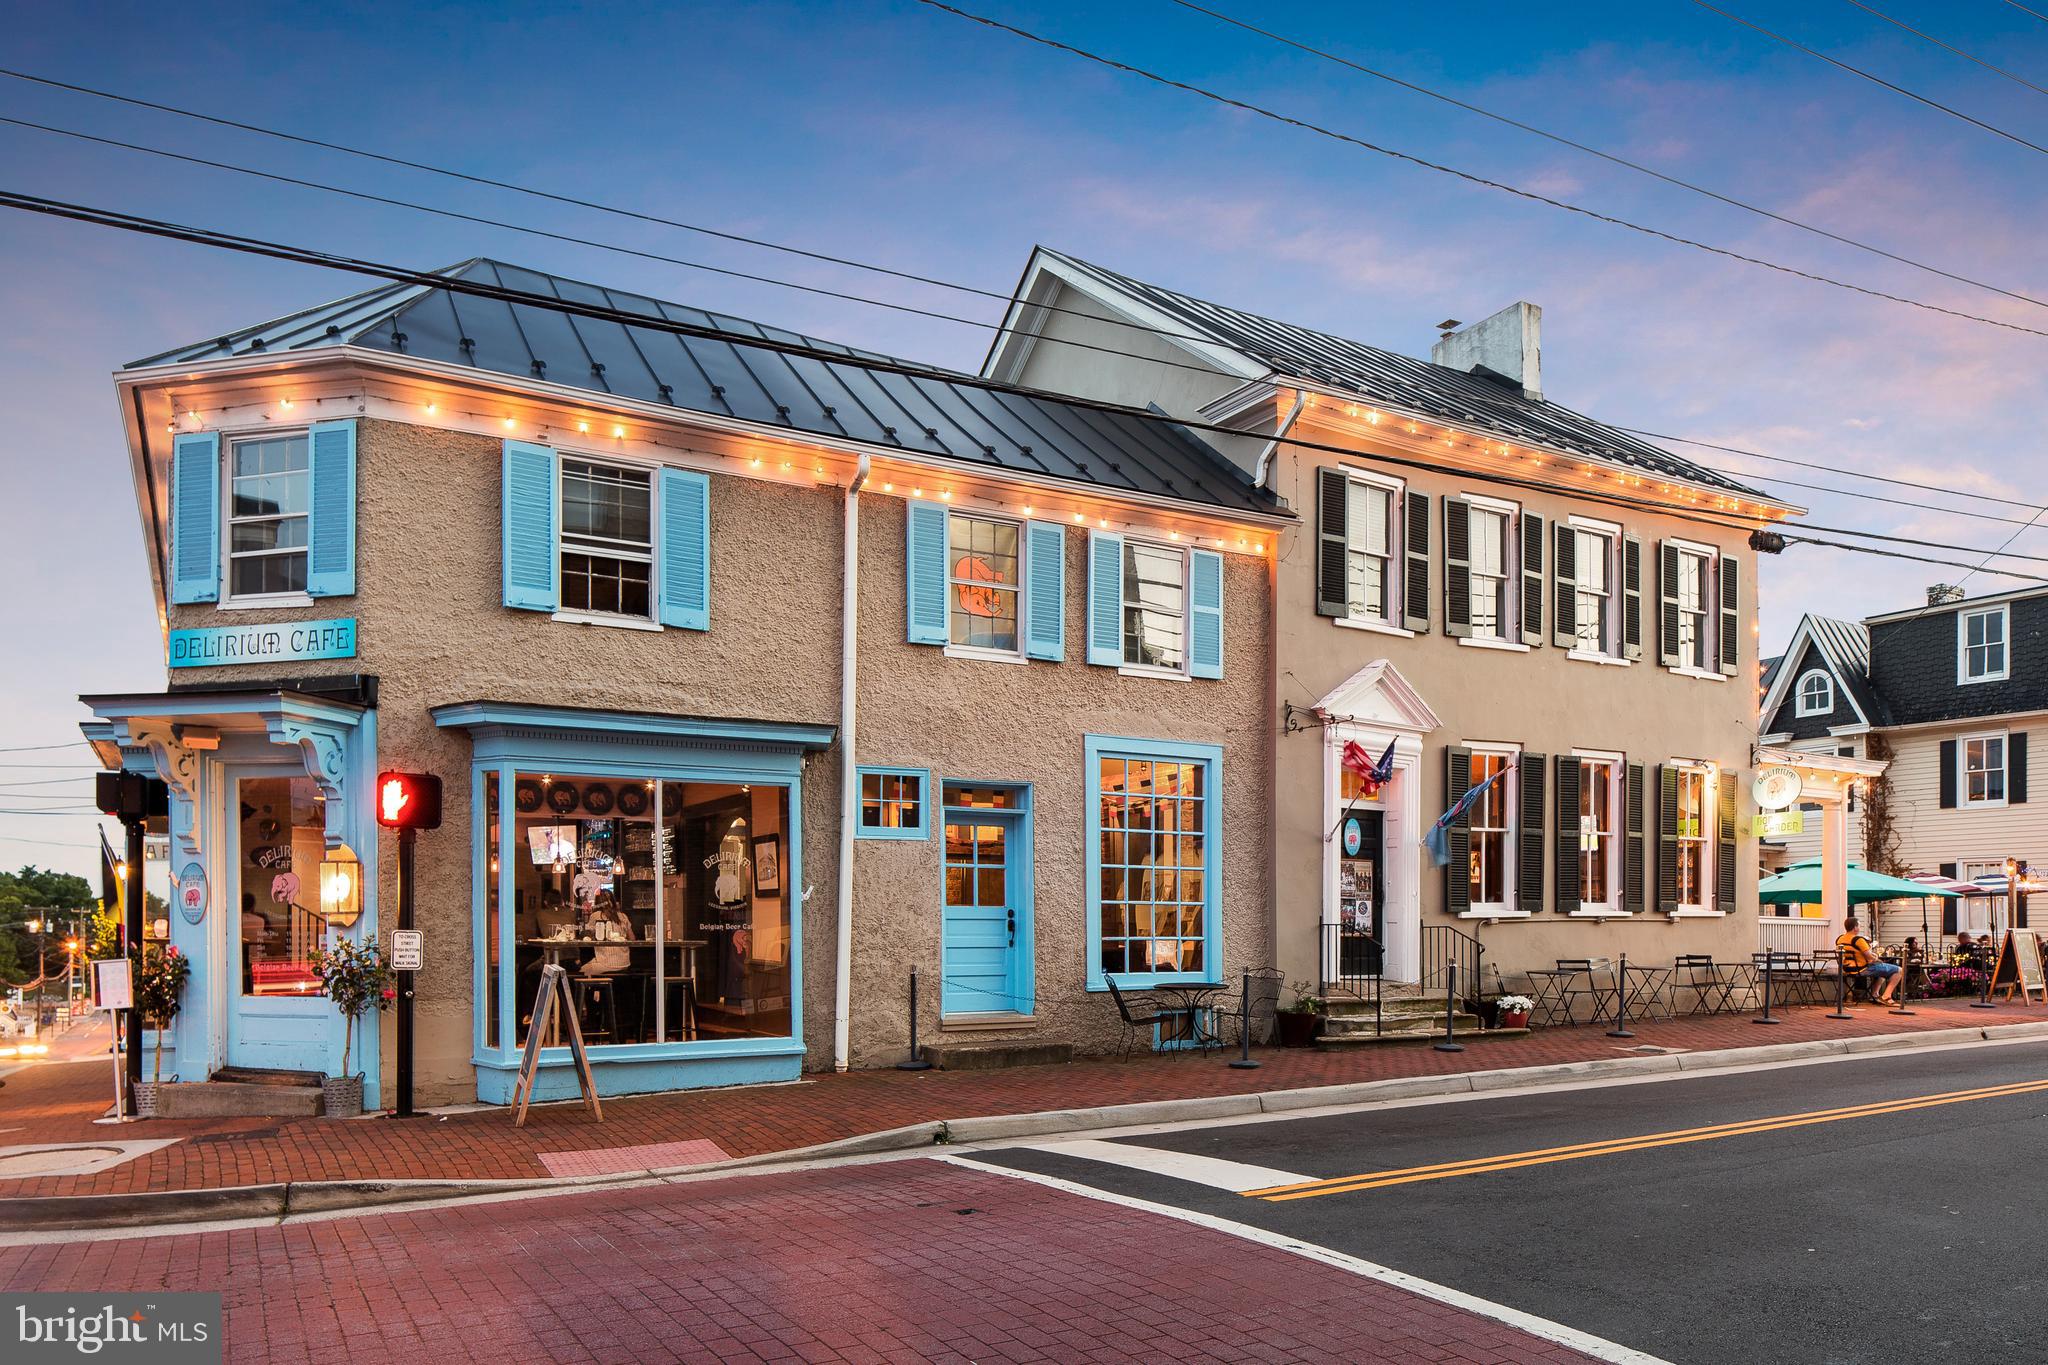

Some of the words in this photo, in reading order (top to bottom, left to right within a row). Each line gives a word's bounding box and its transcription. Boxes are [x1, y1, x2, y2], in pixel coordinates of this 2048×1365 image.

[174, 632, 281, 660] DELIRIUM
[290, 627, 350, 653] CAFE
[1757, 767, 1796, 785] DELIRIUM
[699, 923, 724, 932] Belgian
